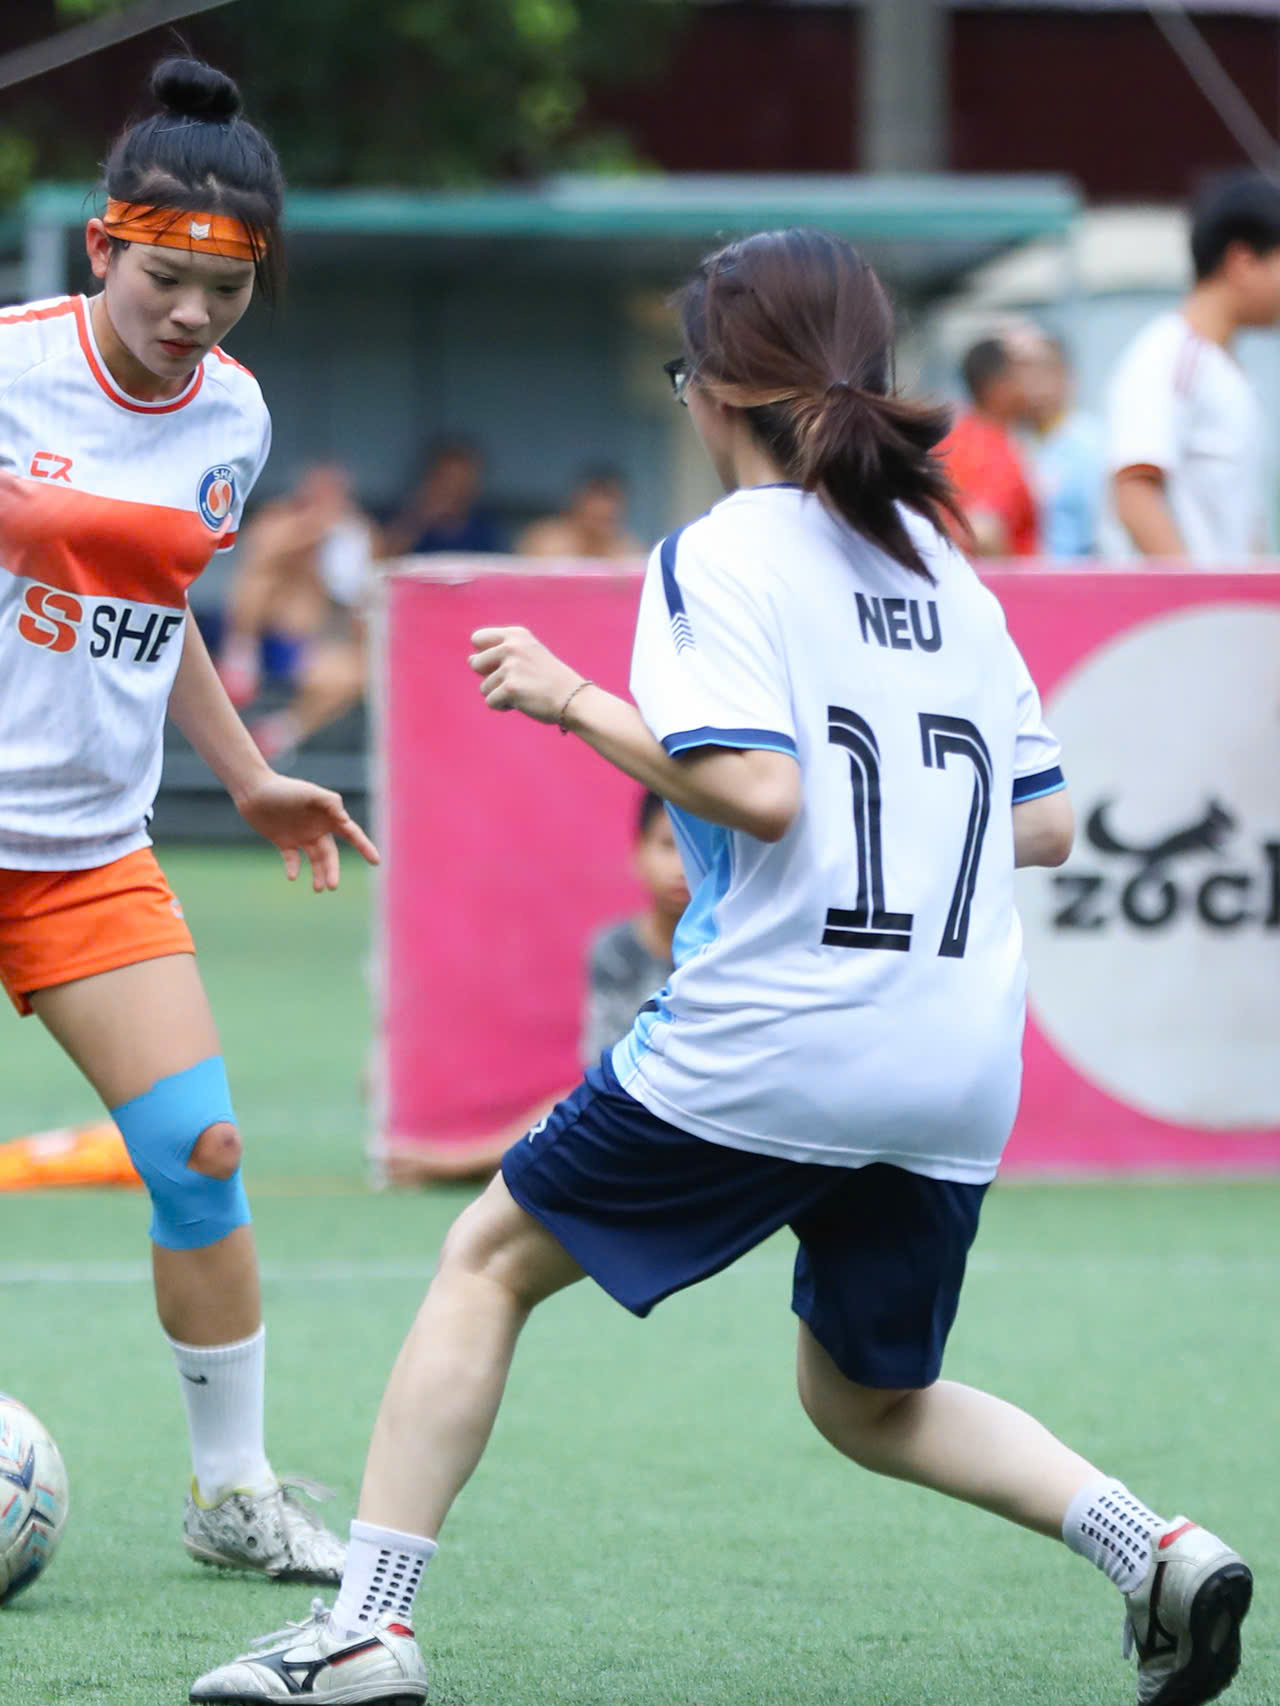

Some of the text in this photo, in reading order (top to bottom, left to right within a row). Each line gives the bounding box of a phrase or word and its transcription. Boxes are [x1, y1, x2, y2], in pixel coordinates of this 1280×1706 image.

[854, 592, 943, 653] NEU
[821, 705, 993, 958] 17
[1051, 841, 1280, 930] zoc
